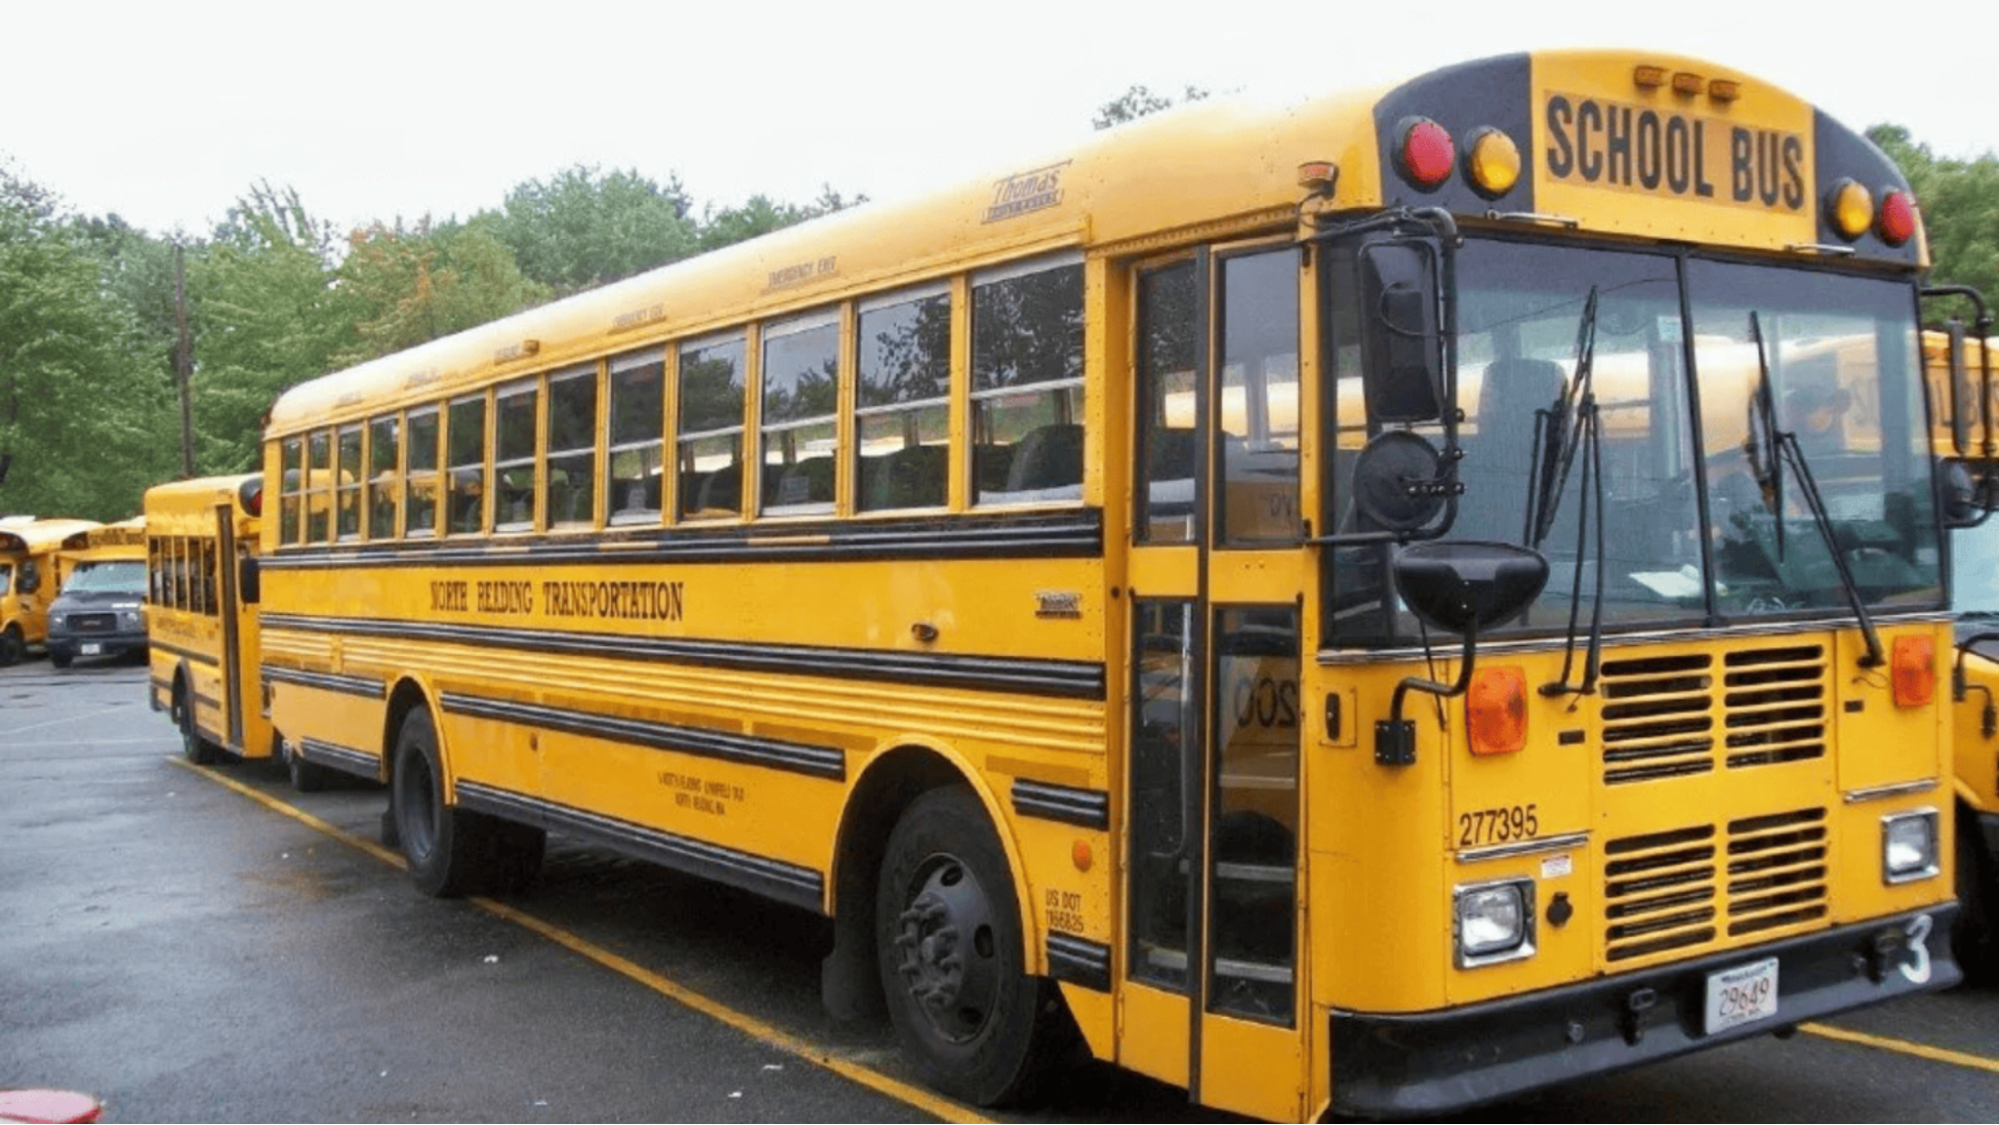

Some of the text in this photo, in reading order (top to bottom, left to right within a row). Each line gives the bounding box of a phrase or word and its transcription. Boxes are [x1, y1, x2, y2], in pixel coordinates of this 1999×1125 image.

[1547, 95, 1804, 210] SCHOOL BUS
[430, 581, 684, 621] NORTH READING TRANSPORTATION
[1460, 803, 1538, 846] 277395
[1046, 888, 1081, 912] US DOT
[1901, 914, 1934, 984] 3
[1719, 977, 1770, 1017] 29649
